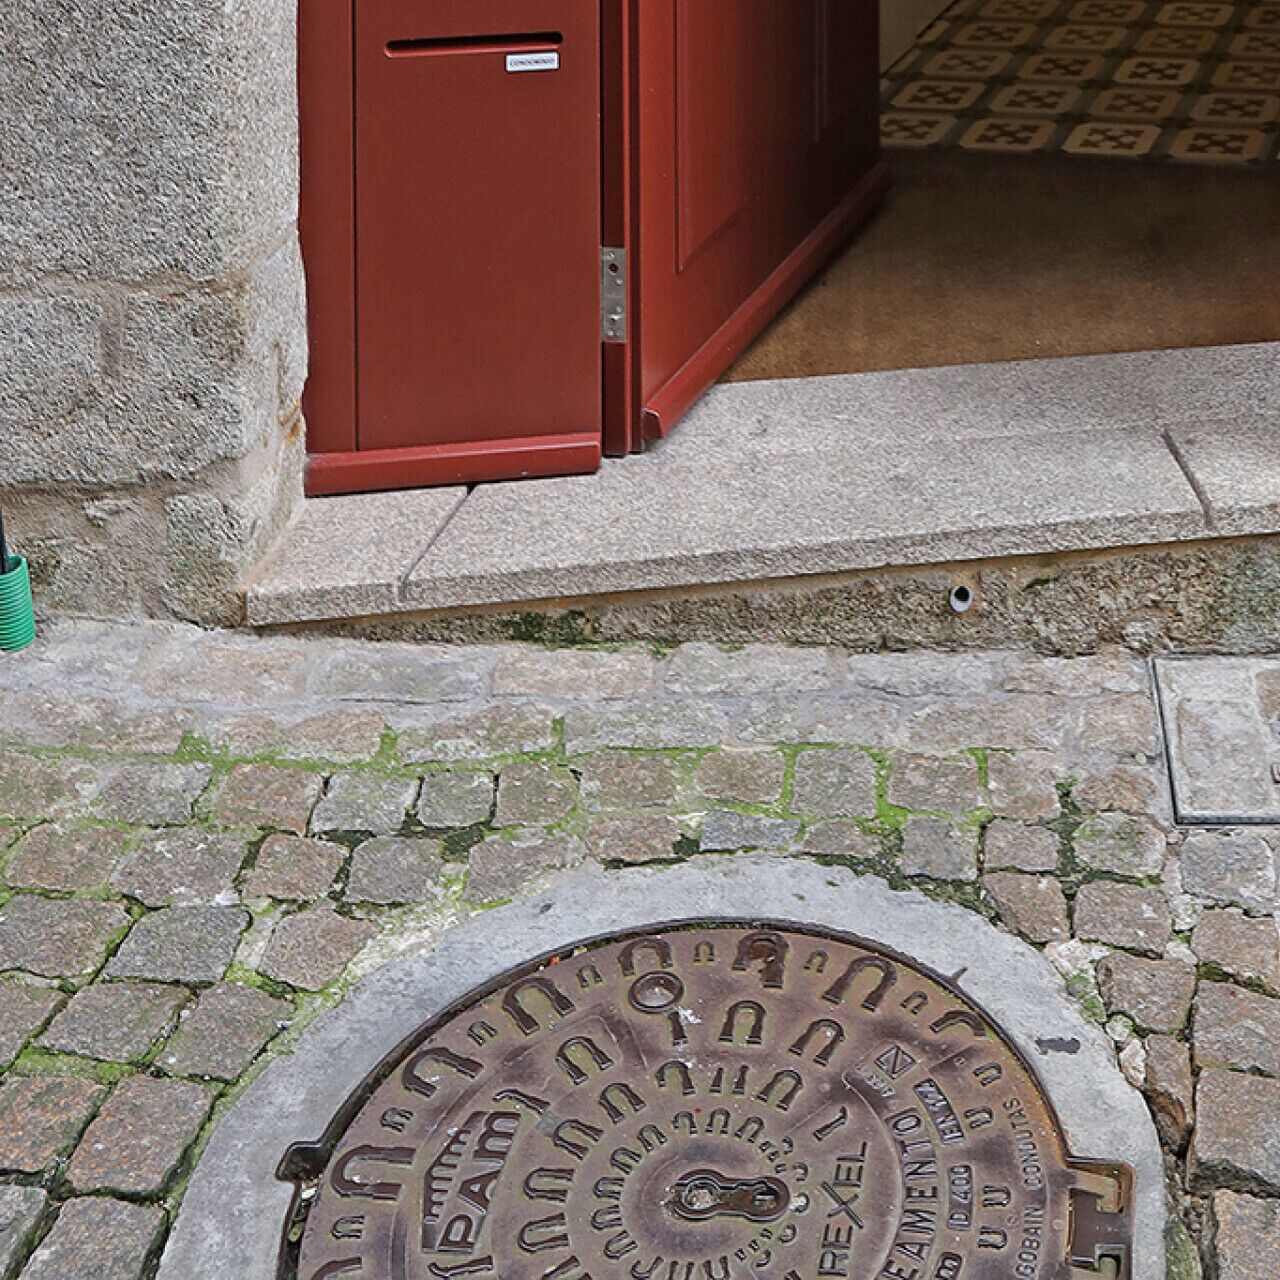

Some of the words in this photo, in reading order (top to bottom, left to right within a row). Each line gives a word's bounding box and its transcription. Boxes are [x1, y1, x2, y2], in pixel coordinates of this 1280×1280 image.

[1002, 1097, 1043, 1190] CONDUTAS
[818, 1141, 867, 1276] REXEL
[951, 1164, 971, 1204] 400
[949, 1212, 969, 1229] D
